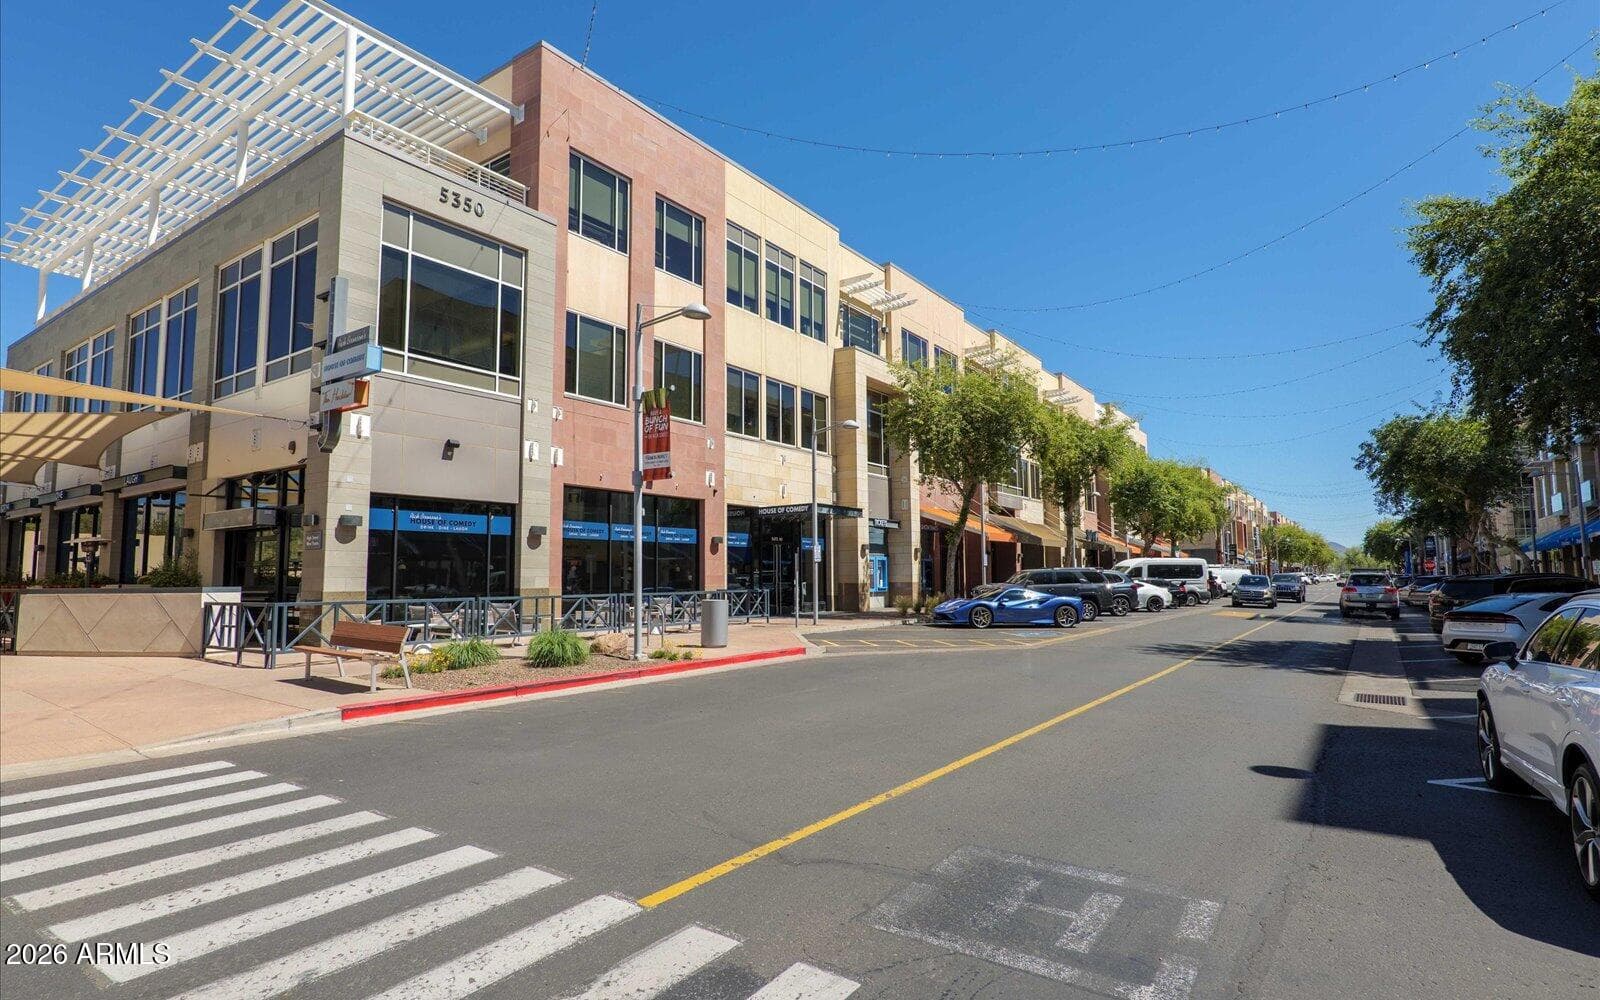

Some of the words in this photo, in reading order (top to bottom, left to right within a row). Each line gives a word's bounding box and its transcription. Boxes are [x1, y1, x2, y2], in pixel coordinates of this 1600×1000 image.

[439, 186, 484, 218] 5350
[645, 414, 668, 426] BUNCH
[644, 425, 653, 434] OF
[655, 423, 669, 432] FUN
[759, 507, 777, 515] HOUSE
[786, 505, 809, 513] COMEDY
